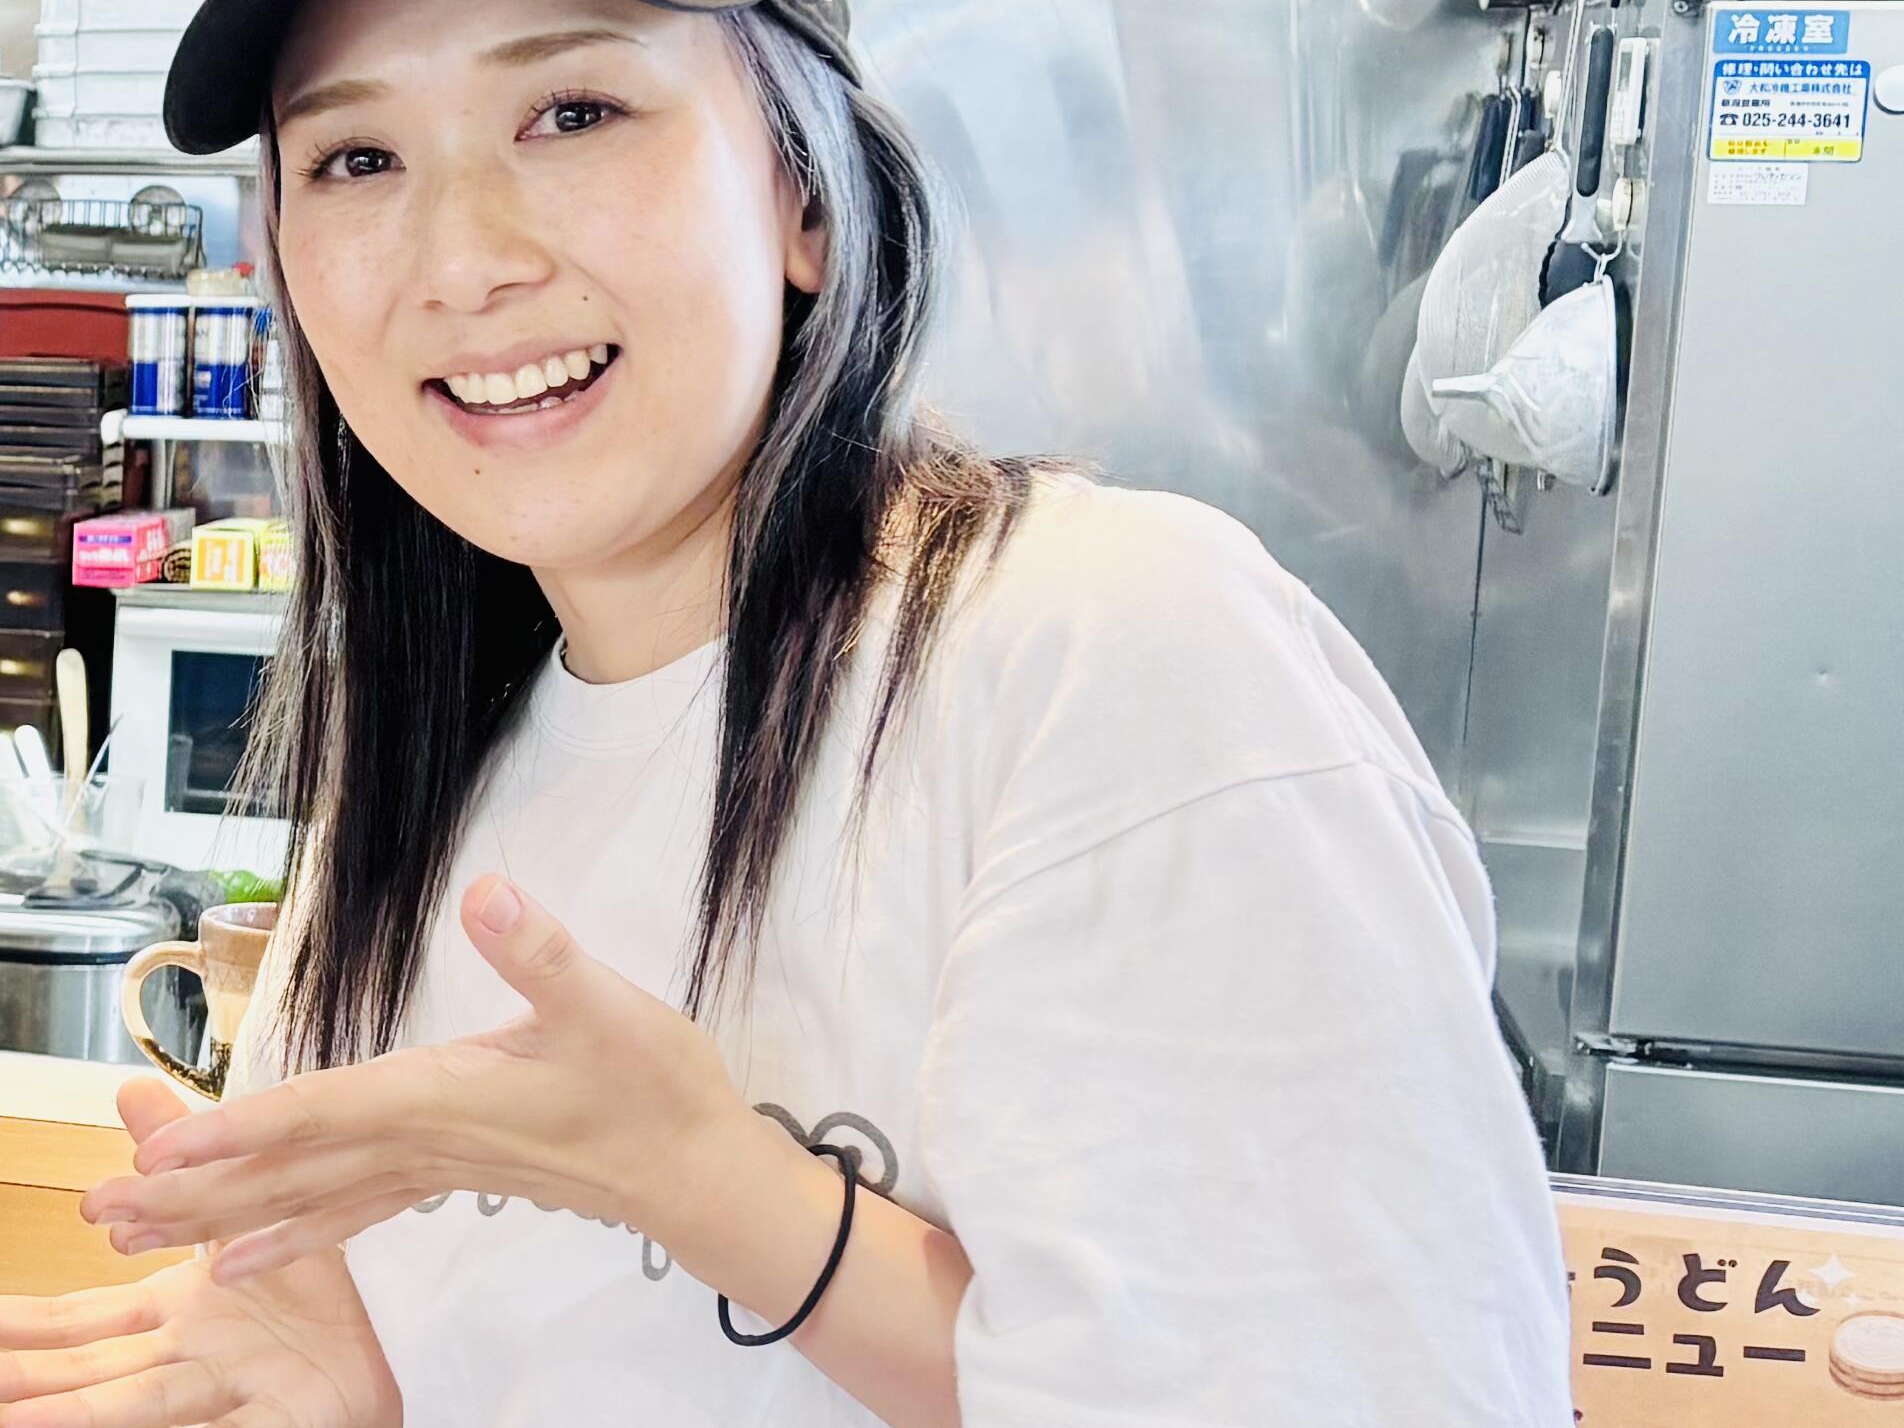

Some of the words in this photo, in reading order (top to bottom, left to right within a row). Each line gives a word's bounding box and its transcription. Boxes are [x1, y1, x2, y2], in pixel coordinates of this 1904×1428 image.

[1728, 13, 1834, 44] 冷凍室
[1722, 62, 1863, 77] 修理・問い合わせ先は
[1743, 112, 1851, 129] 025-244-3641
[1583, 1321, 1806, 1377] ニュー
